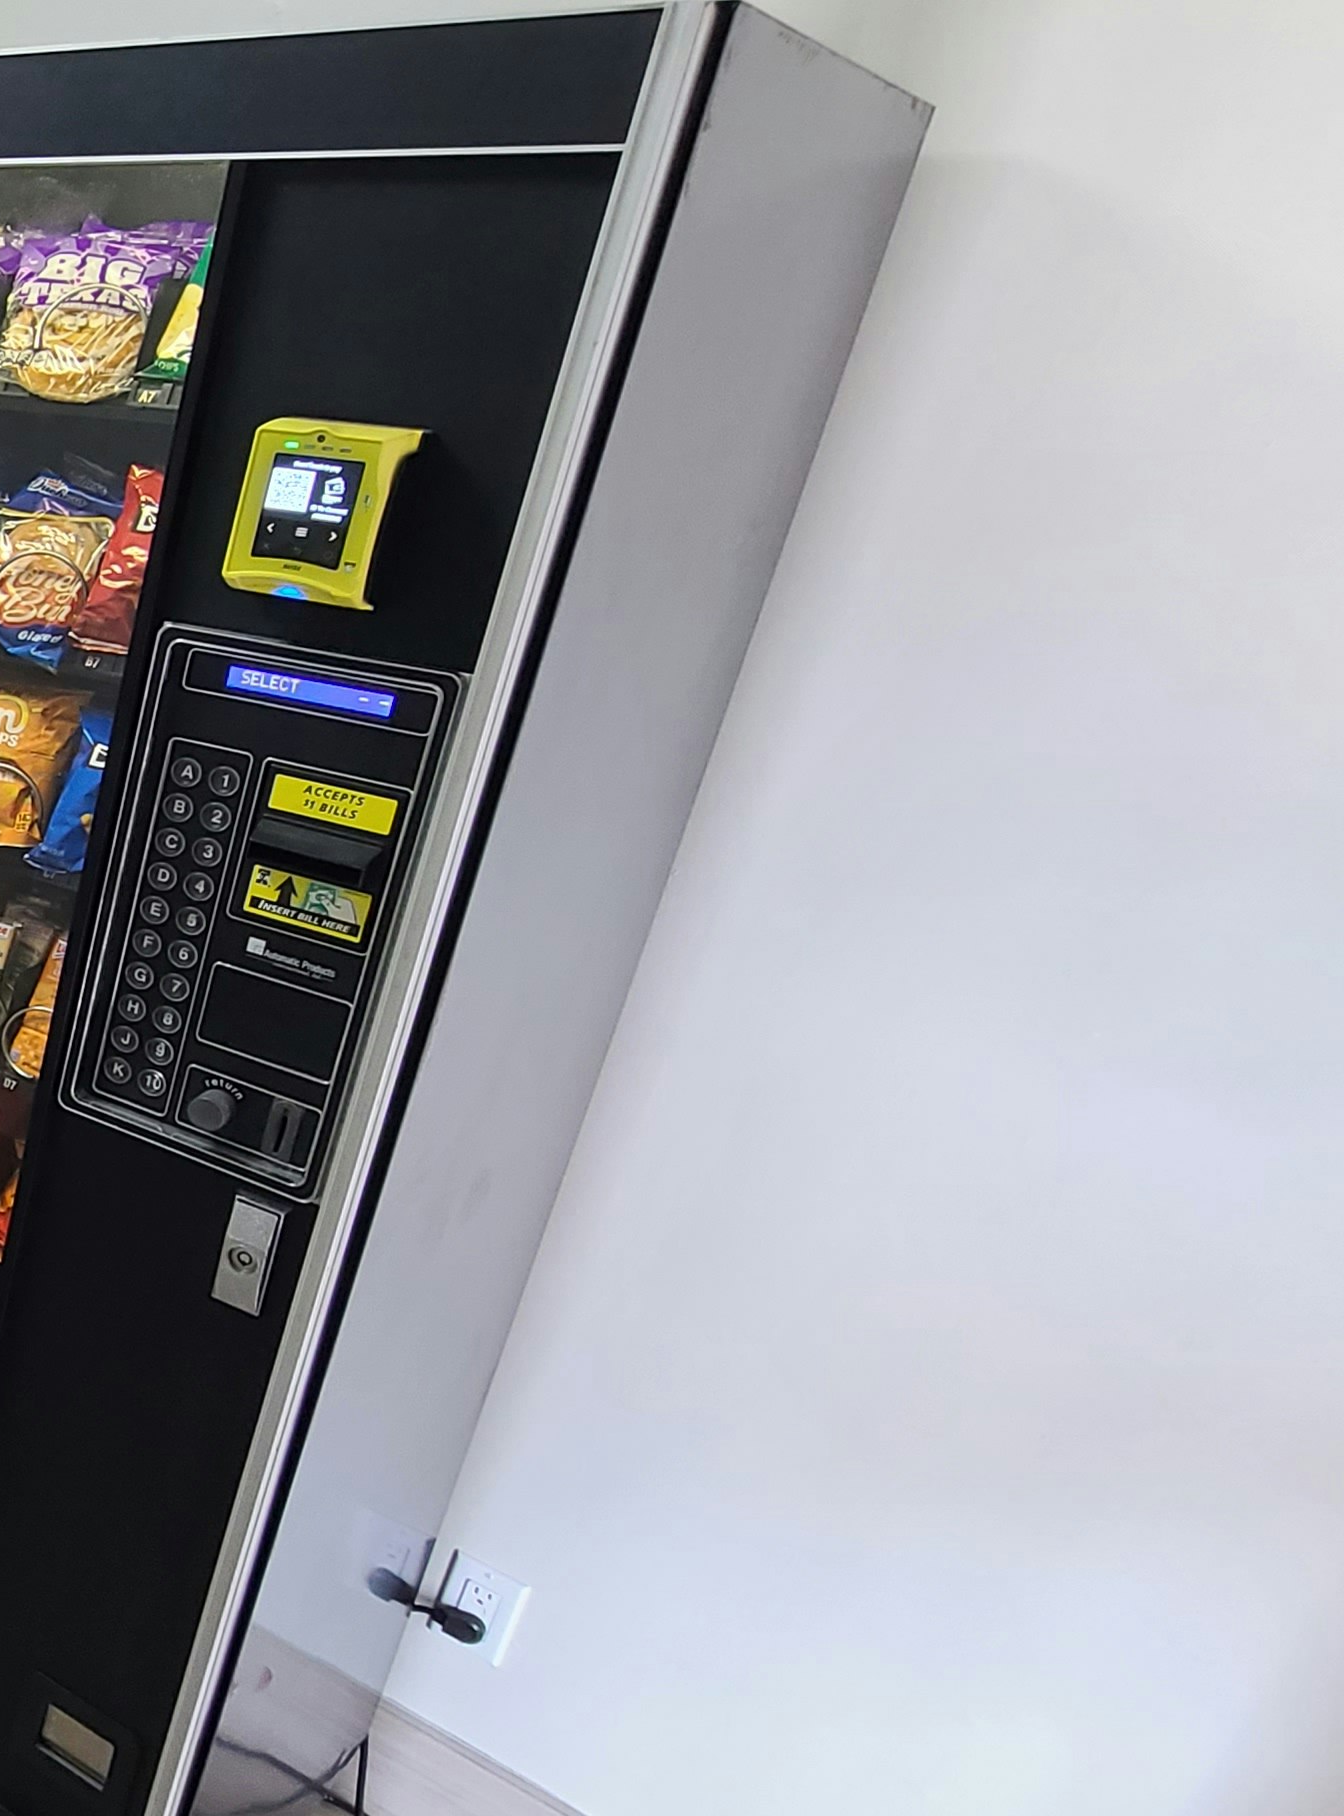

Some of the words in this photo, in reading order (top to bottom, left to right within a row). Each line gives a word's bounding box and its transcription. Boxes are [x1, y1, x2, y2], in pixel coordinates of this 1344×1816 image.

[38, 253, 145, 287] BIG
[22, 281, 149, 312] TEXAS
[138, 391, 157, 404] A7
[2, 586, 72, 623] Bun
[17, 630, 63, 644] Glazed
[84, 657, 101, 669] B7
[241, 671, 301, 693] SELECT
[181, 765, 193, 779] A
[222, 774, 230, 787] 1
[303, 785, 365, 807] ACCEPTS
[173, 800, 186, 814] B
[318, 803, 359, 820] BILLS
[211, 810, 223, 824] 2
[165, 834, 178, 848] C
[202, 844, 214, 859] 3
[157, 868, 170, 882] D
[194, 880, 205, 894] 4
[150, 902, 161, 917] E
[258, 900, 297, 918] INSERT
[297, 912, 319, 925] BILL
[321, 920, 351, 933] HERE
[186, 913, 198, 927] 5
[142, 935, 154, 949] F
[178, 947, 189, 961] 6
[134, 968, 146, 983] G
[301, 960, 336, 978] Products
[171, 980, 182, 993] 7
[127, 1000, 140, 1015] H
[162, 1012, 174, 1026] 8
[120, 1033, 131, 1045] J
[155, 1042, 165, 1057] 9
[113, 1062, 124, 1077] K
[3, 1077, 17, 1089] D7
[145, 1074, 162, 1091] 10
[205, 1079, 244, 1100] return
